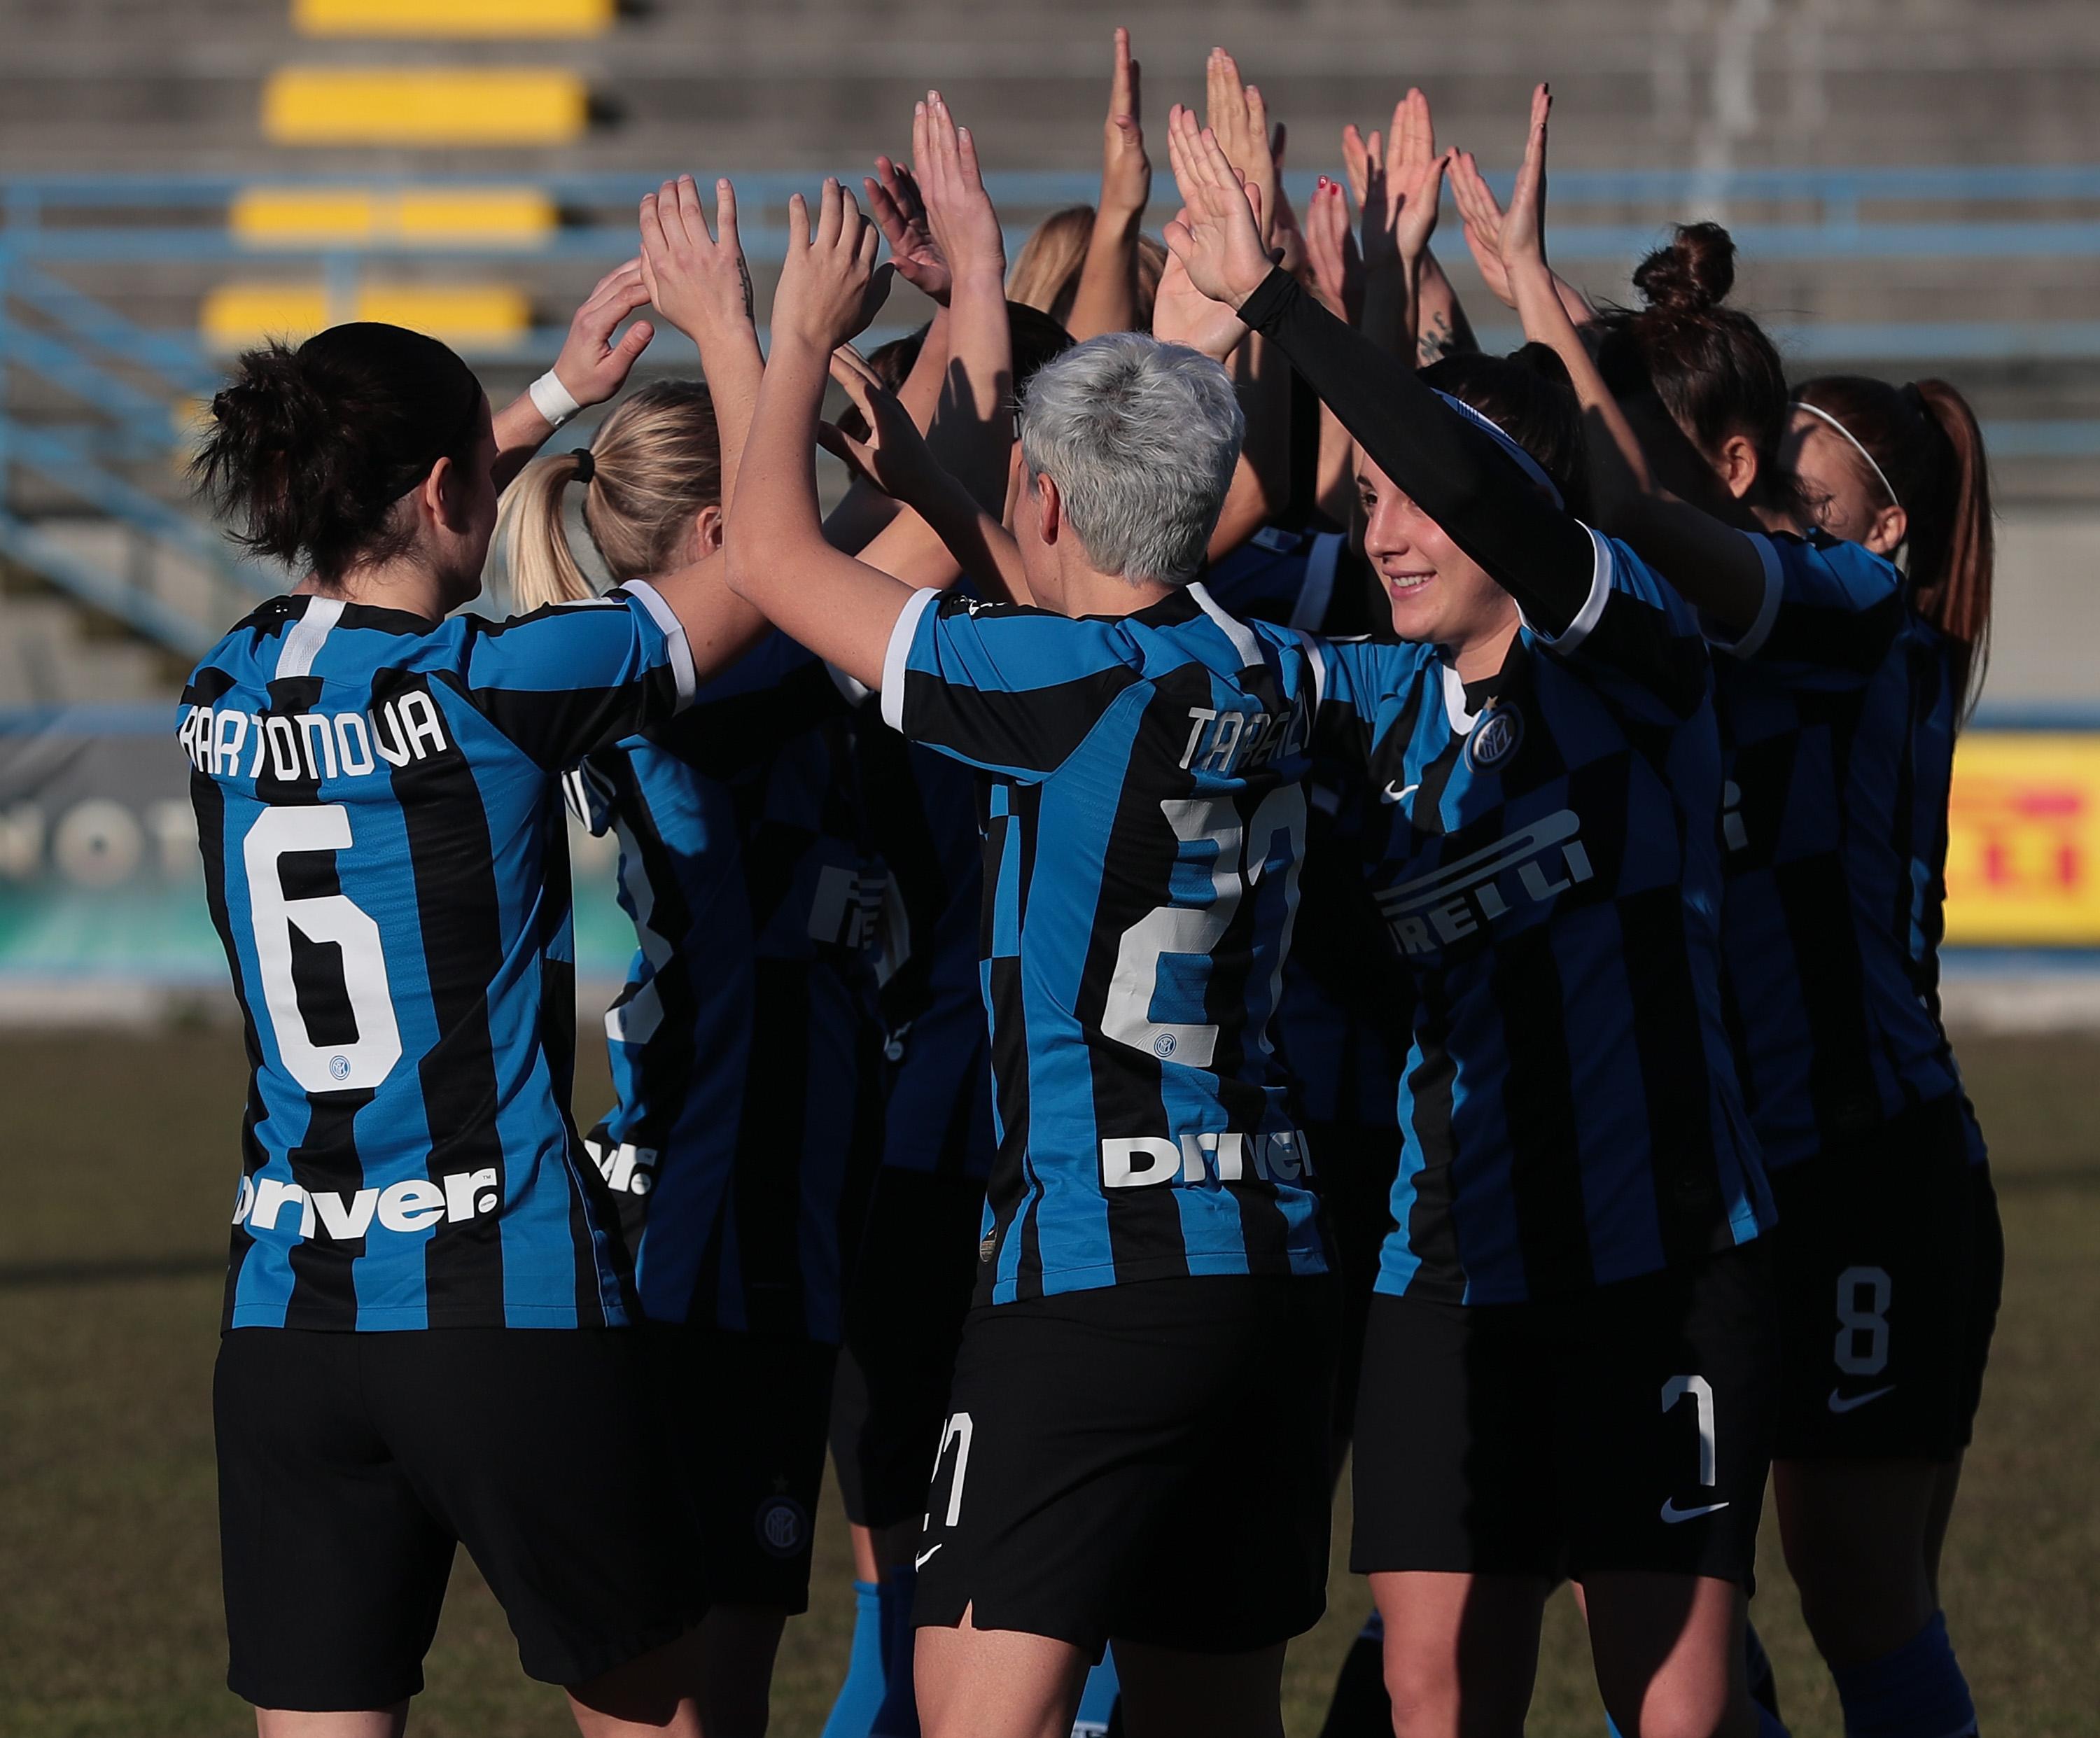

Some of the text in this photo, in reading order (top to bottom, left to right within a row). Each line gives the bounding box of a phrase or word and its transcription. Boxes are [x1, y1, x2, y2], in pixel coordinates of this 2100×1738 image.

[243, 804, 402, 1093] 6
[1100, 780, 1308, 1067] 27
[1373, 808, 1595, 955] PRELLI
[1833, 1266, 1891, 1377] 8
[923, 1412, 974, 1527] 7
